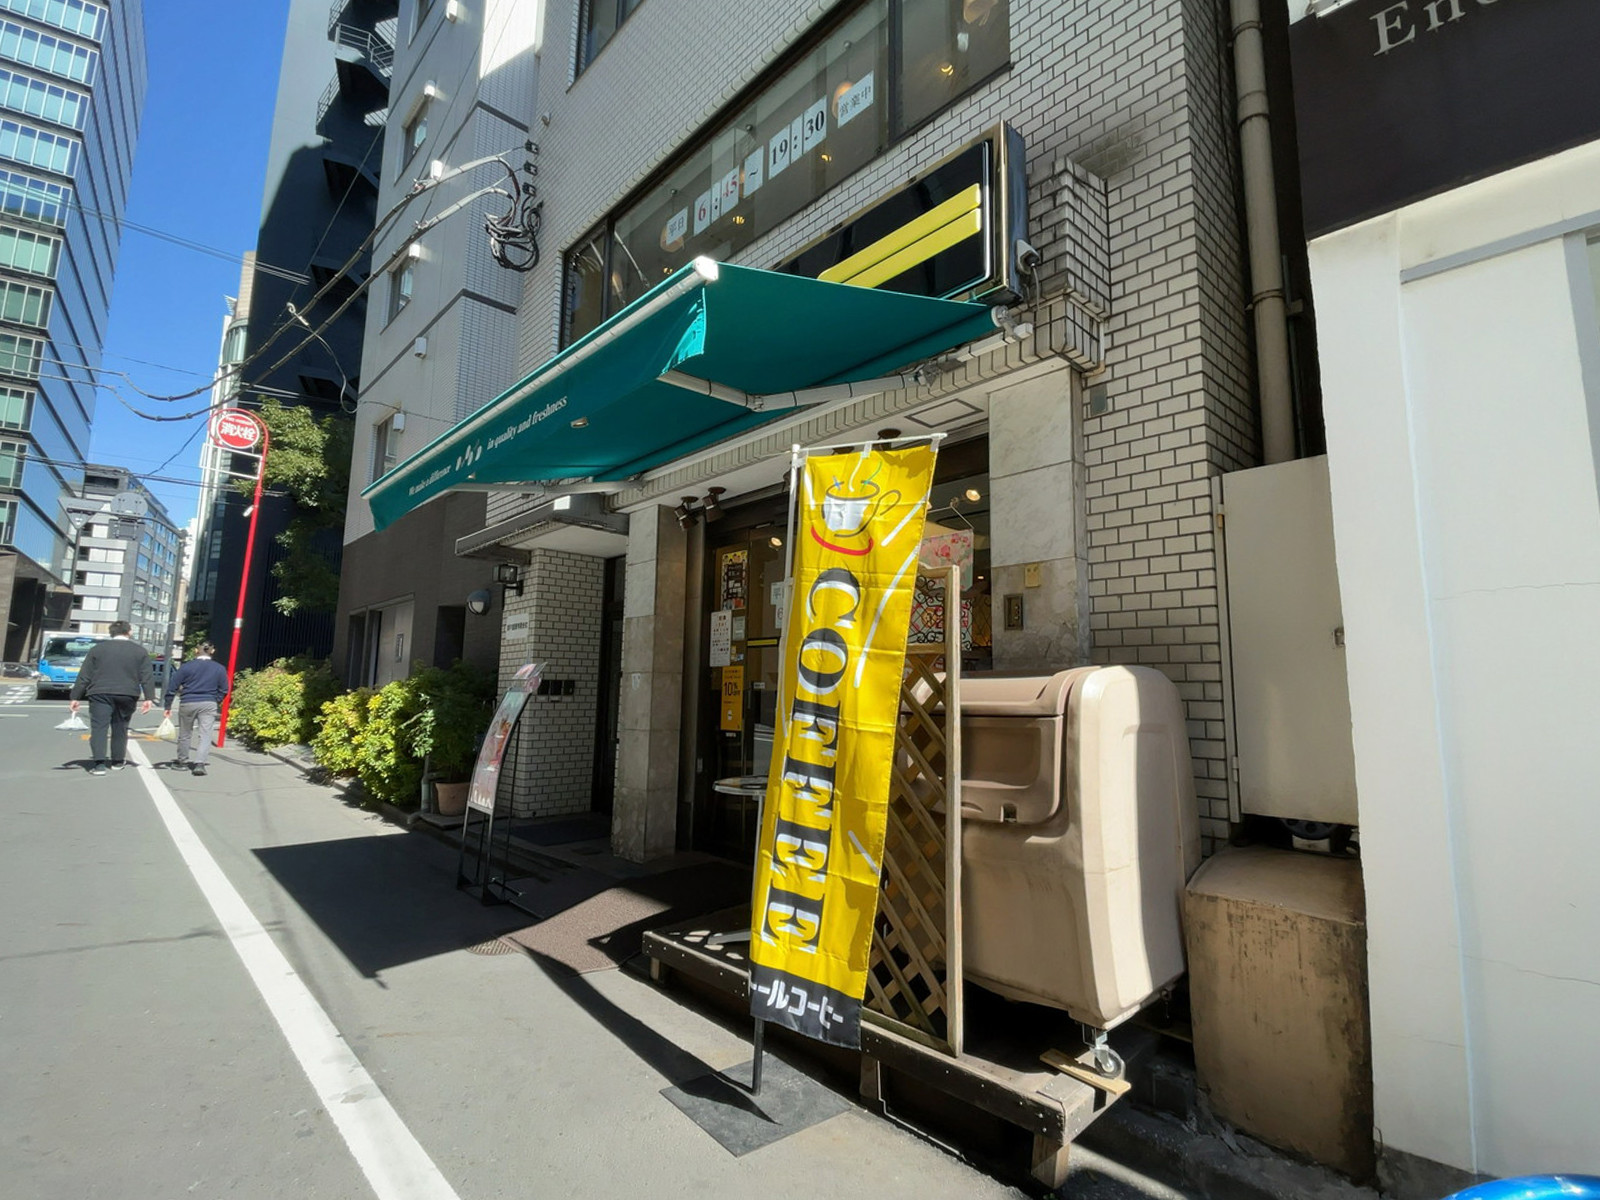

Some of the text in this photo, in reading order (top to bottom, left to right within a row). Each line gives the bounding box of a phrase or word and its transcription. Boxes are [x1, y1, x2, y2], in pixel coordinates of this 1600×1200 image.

[1369, 0, 1500, 57] En
[771, 110, 825, 166] 19:30
[839, 83, 872, 118] 営業中
[220, 422, 256, 442] 消火栓
[517, 414, 532, 434] and
[532, 396, 568, 424] freshness
[762, 567, 861, 954] COFFEE
